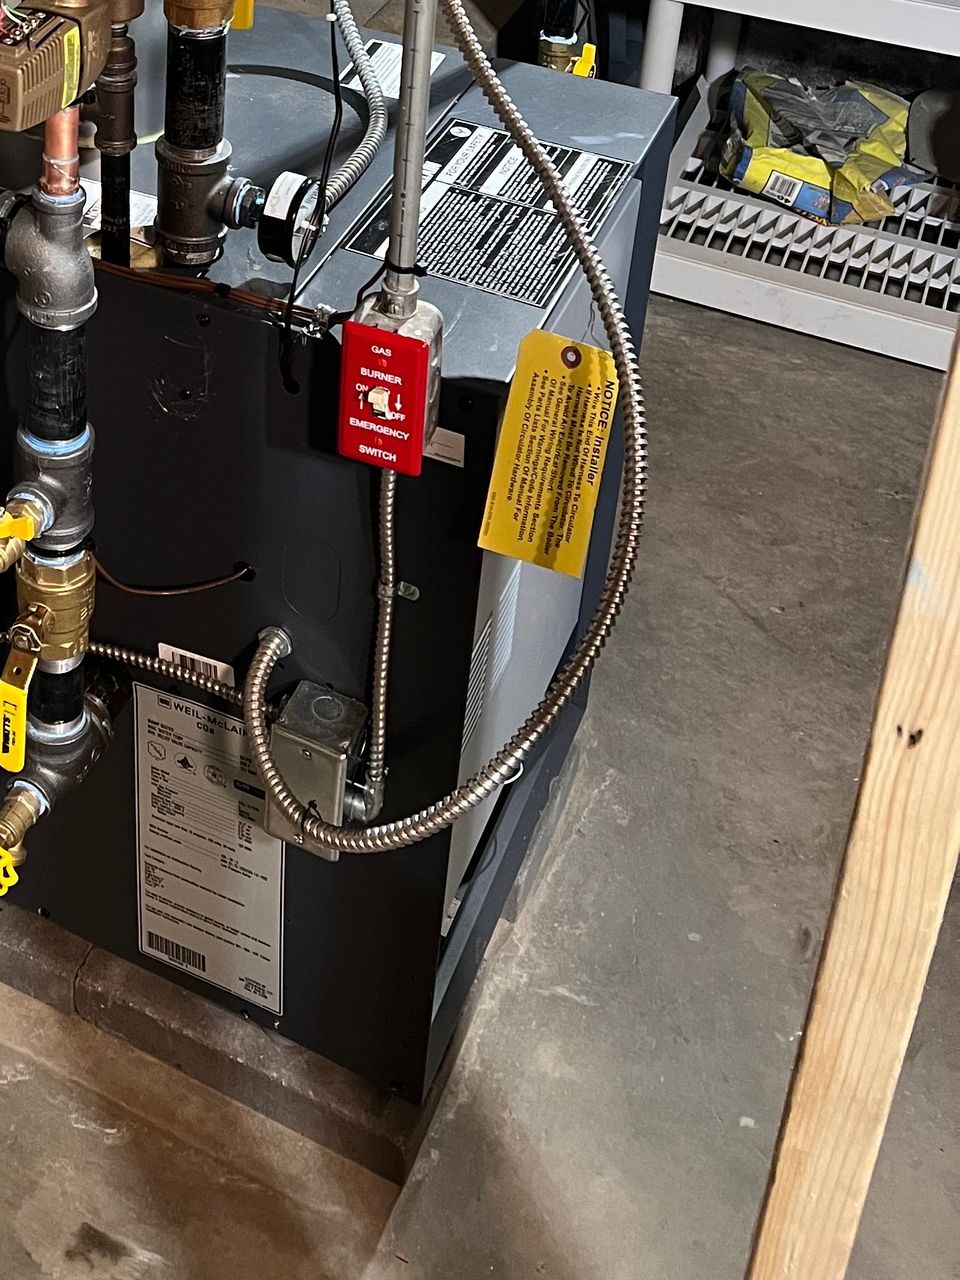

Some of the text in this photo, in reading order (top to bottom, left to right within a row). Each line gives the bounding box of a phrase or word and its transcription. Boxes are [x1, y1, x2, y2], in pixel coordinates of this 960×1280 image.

[497, 156, 519, 175] NOTICE
[371, 345, 392, 357] GAS
[355, 383, 369, 392] ON
[360, 367, 402, 385] BURNER
[524, 371, 539, 410] Assembly
[567, 384, 575, 393] To
[391, 412, 406, 422] OFF
[523, 411, 531, 422] Of
[562, 394, 572, 418] Avoid
[578, 396, 591, 428] Harness
[349, 416, 410, 441] EMERGENCY
[559, 418, 567, 429] An
[586, 380, 615, 485] NOTICE: Installer
[359, 444, 397, 462] SWITCH
[512, 375, 549, 521] See Parts Lists Section Of Manual For
[515, 422, 529, 462] Circulator
[552, 431, 565, 468] Electrical
[573, 438, 582, 453] Not
[517, 378, 557, 541] Of Manual For Warnings/Code Information.
[527, 380, 566, 542] See General Wiring Requirements Section
[543, 386, 584, 555] Harness Must Be Removed From The Boiler
[564, 392, 600, 543] Wire This End Of Harness To Circulator
[569, 454, 579, 478] Wired
[567, 479, 574, 489] To
[554, 533, 563, 548] The
[173, 702, 249, 737] WEIL-McLAIN
